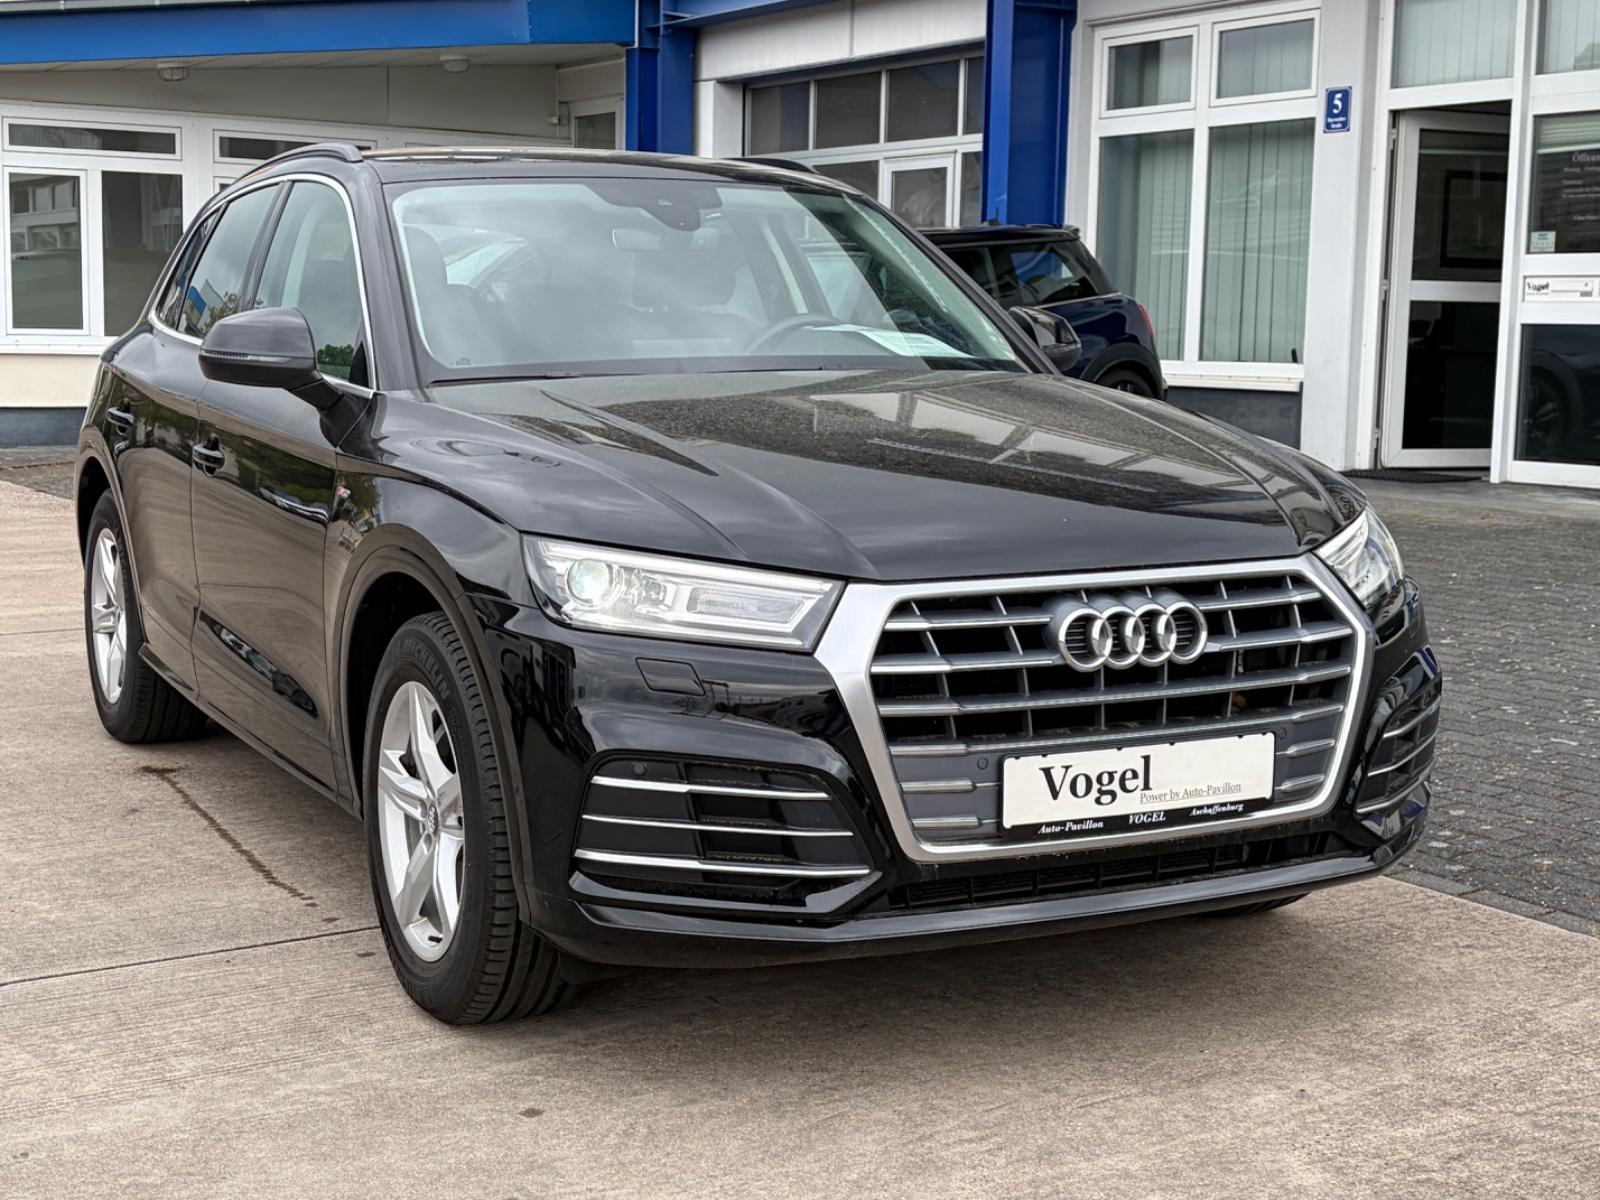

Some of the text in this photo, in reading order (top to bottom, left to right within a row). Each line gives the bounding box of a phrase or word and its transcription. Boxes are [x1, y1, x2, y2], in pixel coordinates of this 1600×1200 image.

[1332, 93, 1342, 114] 5
[1039, 754, 1153, 806] Vogel
[1140, 782, 1241, 803] Power by Auto-Pavillon
[1038, 803, 1244, 834] Auto-Pavillon VOGEL Aschaffenburg
